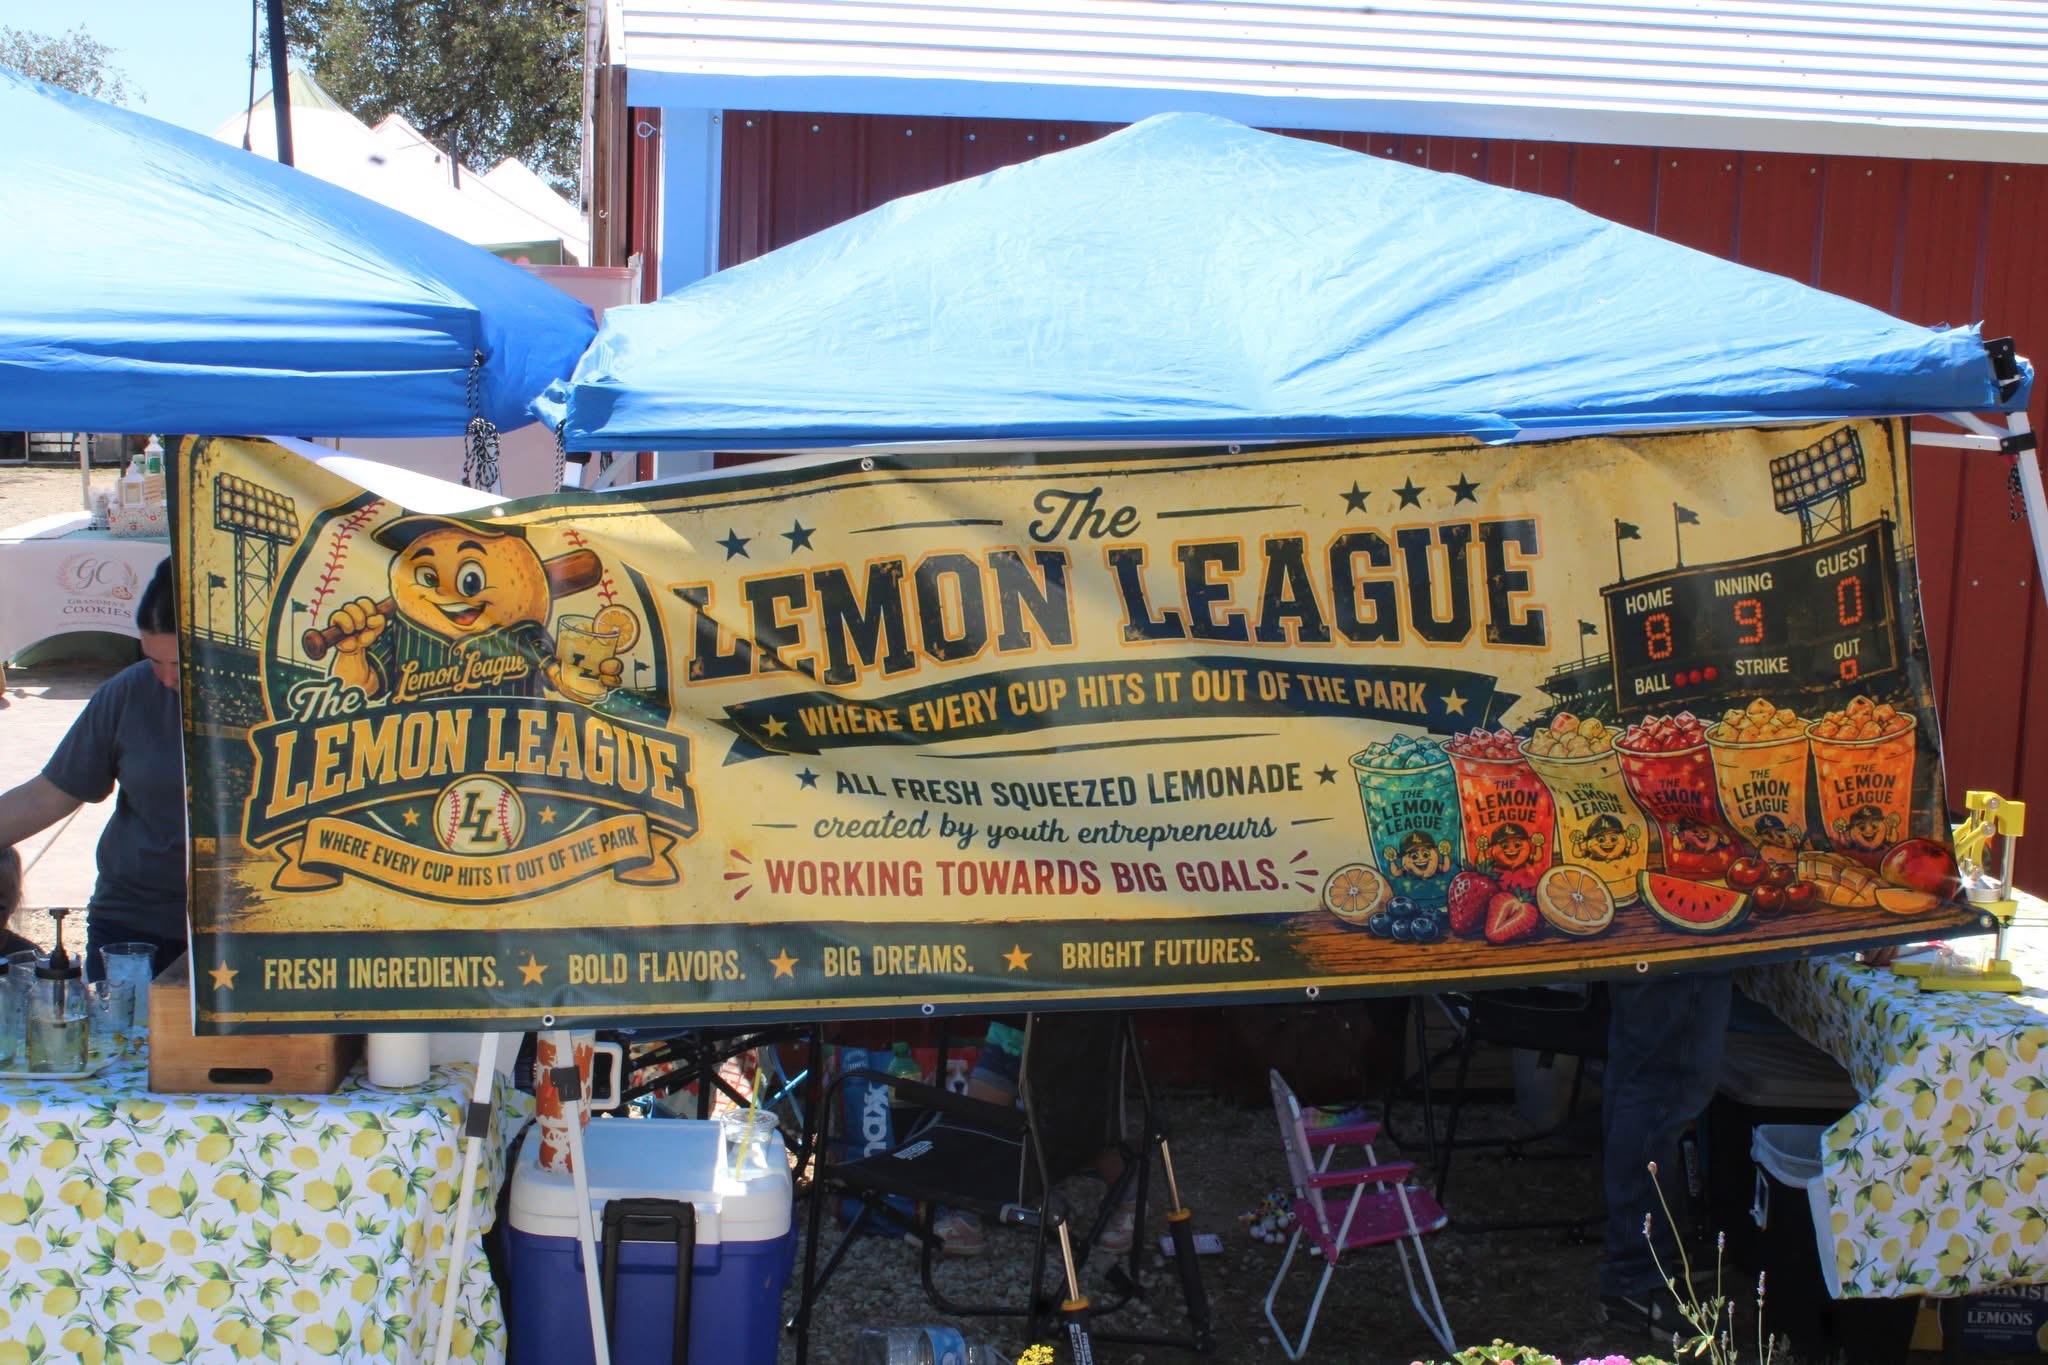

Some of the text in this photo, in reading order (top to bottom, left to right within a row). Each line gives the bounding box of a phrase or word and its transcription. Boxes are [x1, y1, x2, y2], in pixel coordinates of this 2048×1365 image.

[1029, 486, 1141, 543] The
[1816, 543, 1868, 578] GUEST
[1715, 572, 1773, 597] INNING
[63, 606, 132, 618] COOKIES
[667, 515, 1552, 688] LEMON LEAGUE
[1625, 587, 1672, 616] HOME
[1837, 575, 1862, 626] 0
[1734, 598, 1763, 644] 9
[1645, 612, 1673, 660] 8
[1834, 638, 1861, 660] OUT
[393, 660, 461, 703] Lemon
[455, 647, 529, 693] League
[1735, 657, 1789, 676] STRIKE
[1635, 673, 1671, 696] BALL
[294, 681, 362, 722] The
[798, 669, 1428, 737] WHERE EVERY CUP HITS IT OUT OF THE PARK
[266, 708, 686, 819] LEMON LEAGUE
[1750, 769, 1771, 779] THE
[1854, 763, 1877, 774] THE
[835, 762, 1304, 810] ALL FRESH SQUEEZED LEMONADE
[1400, 790, 1424, 799] THE
[1494, 780, 1516, 790] THE
[1576, 782, 1595, 790] THE
[1658, 778, 1681, 788] THE
[1733, 779, 1791, 803] LEMON
[1834, 773, 1897, 795] LEMON
[1475, 790, 1539, 812] LEMON
[1565, 789, 1620, 804] LEMON
[1647, 788, 1702, 806] LEMON
[1838, 790, 1894, 810] LEAGUE
[458, 792, 499, 844] LL
[1382, 799, 1445, 820] LEMON
[1479, 808, 1537, 827] LEAGUE
[1574, 801, 1626, 821] LEAGUE
[1738, 799, 1790, 820] LEAGUE
[813, 809, 1277, 852] created by youth entrepreneurs
[1385, 815, 1444, 836] LEAGUE
[319, 825, 639, 887] WHERE EVERY CUP HITS IT OUT OF THE PARK
[765, 856, 1290, 897] WORKING TOWARDS BIG GOALS.
[824, 943, 975, 977] BIG DREAMS.
[1061, 937, 1262, 970] BRIGHT FUTURES.
[264, 955, 505, 990] FRESH INGREDIENTS.
[568, 949, 746, 985] BOLD FLAVORS.
[1967, 1311, 2033, 1326] LEMONS
